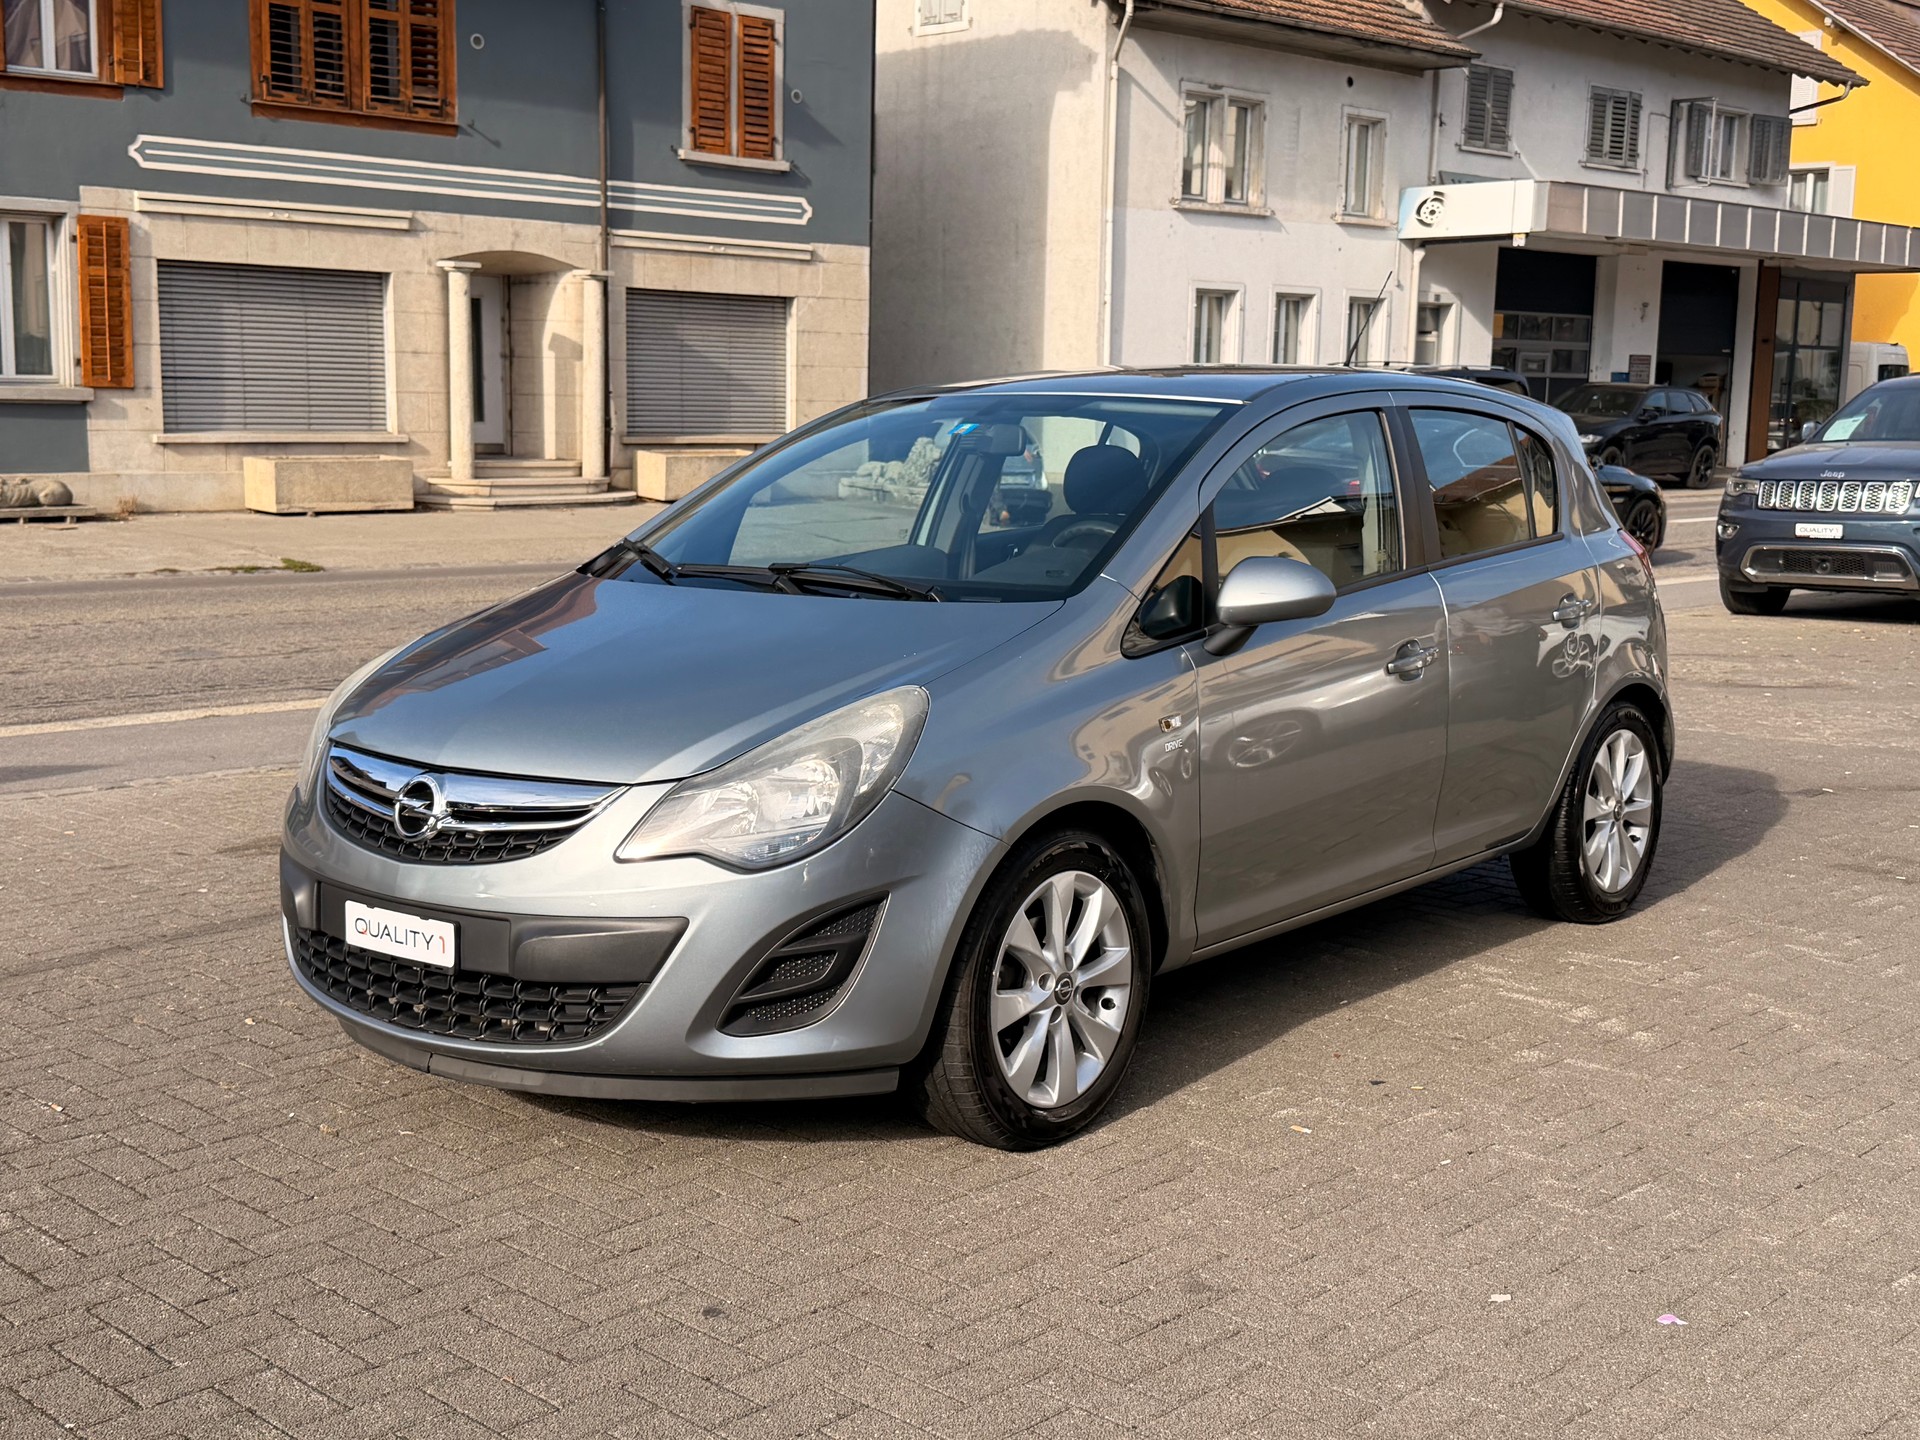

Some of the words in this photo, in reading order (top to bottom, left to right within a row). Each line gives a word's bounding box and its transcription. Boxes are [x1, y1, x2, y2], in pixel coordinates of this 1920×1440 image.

[1820, 470, 1845, 479] Jeep
[1164, 738, 1183, 752] DRIVE
[355, 917, 434, 951] QUALITY
[438, 935, 446, 954] 1
